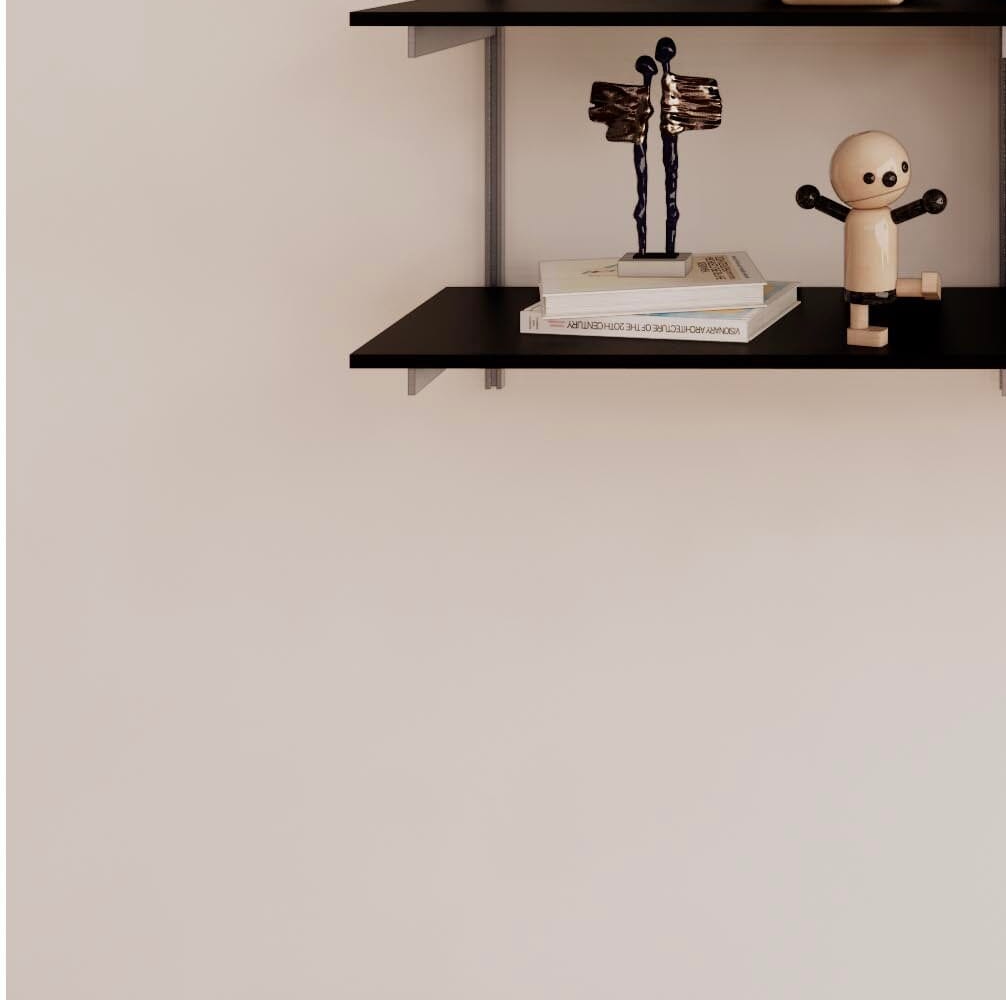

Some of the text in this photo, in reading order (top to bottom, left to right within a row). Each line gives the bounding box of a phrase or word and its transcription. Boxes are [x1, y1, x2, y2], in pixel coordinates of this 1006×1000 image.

[567, 320, 603, 331] CENTURY
[603, 322, 625, 331] 20TH
[625, 322, 640, 332] THE
[640, 323, 652, 333] OF
[652, 324, 706, 335] ARCHITECTURE
[705, 326, 741, 336] VISIONARY
